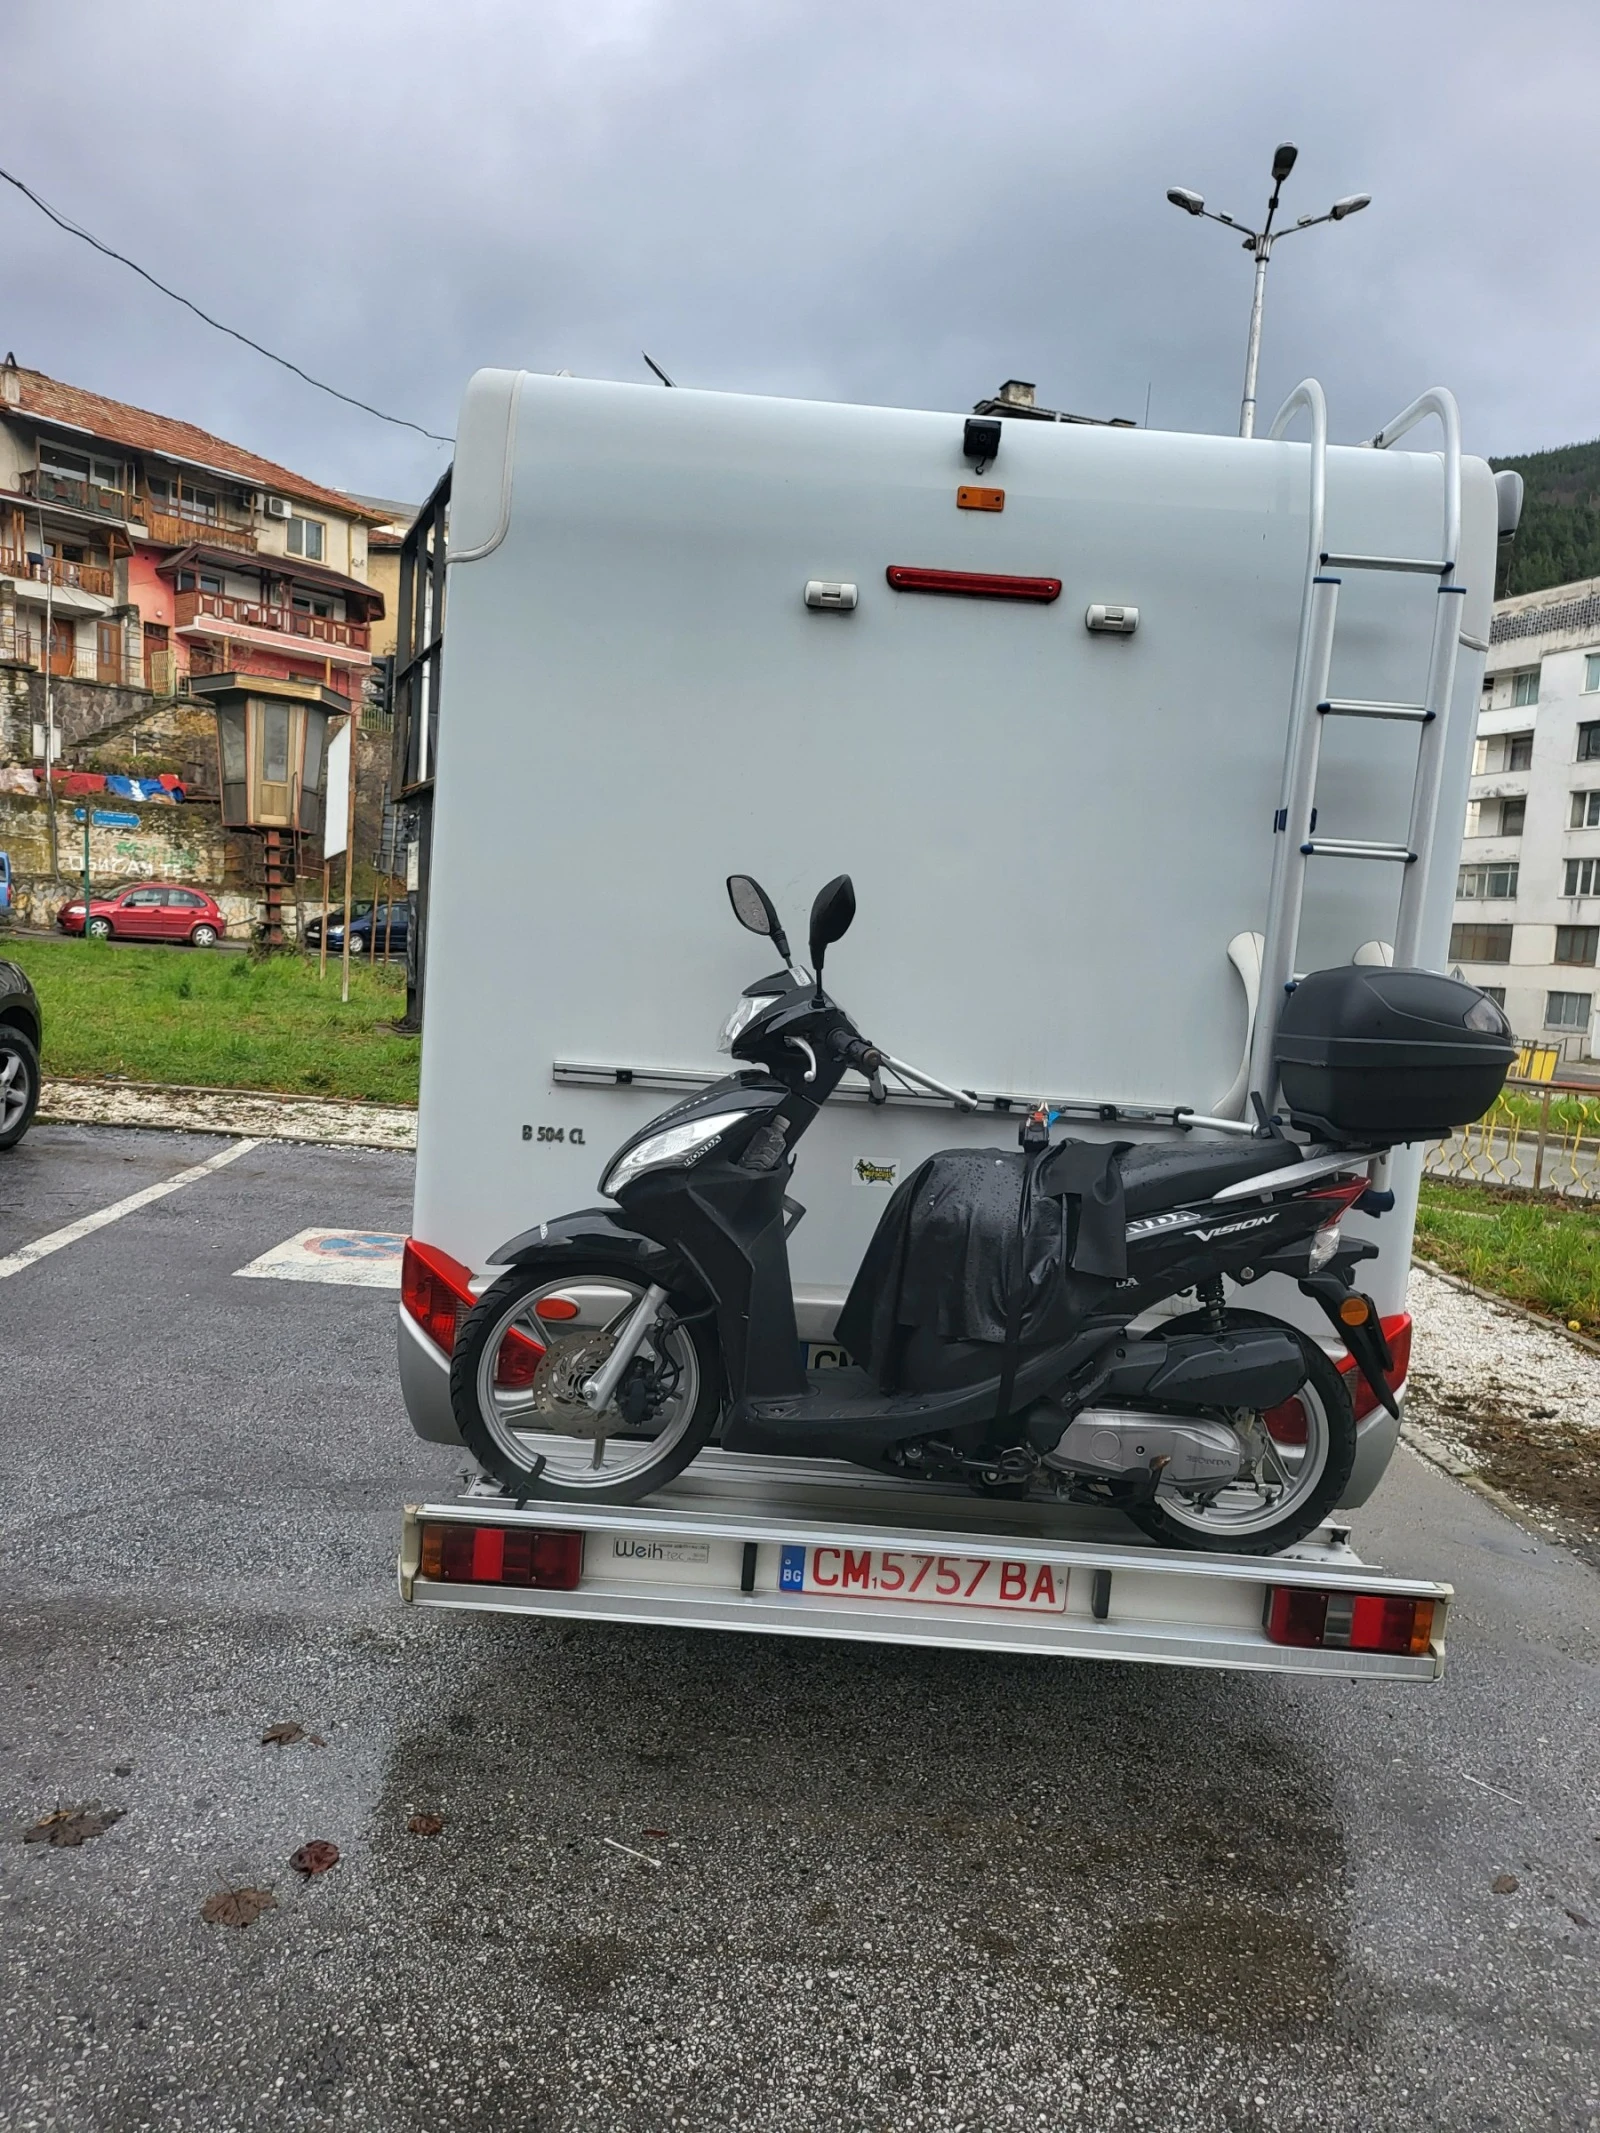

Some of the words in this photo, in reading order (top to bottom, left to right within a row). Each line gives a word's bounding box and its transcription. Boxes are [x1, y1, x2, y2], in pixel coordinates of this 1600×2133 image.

[522, 1124, 533, 1141] B
[537, 1126, 565, 1143] 504
[569, 1128, 586, 1145] CL
[683, 1134, 722, 1167] HONDA
[1184, 1213, 1280, 1241] VISION
[782, 1569, 802, 1583] BG
